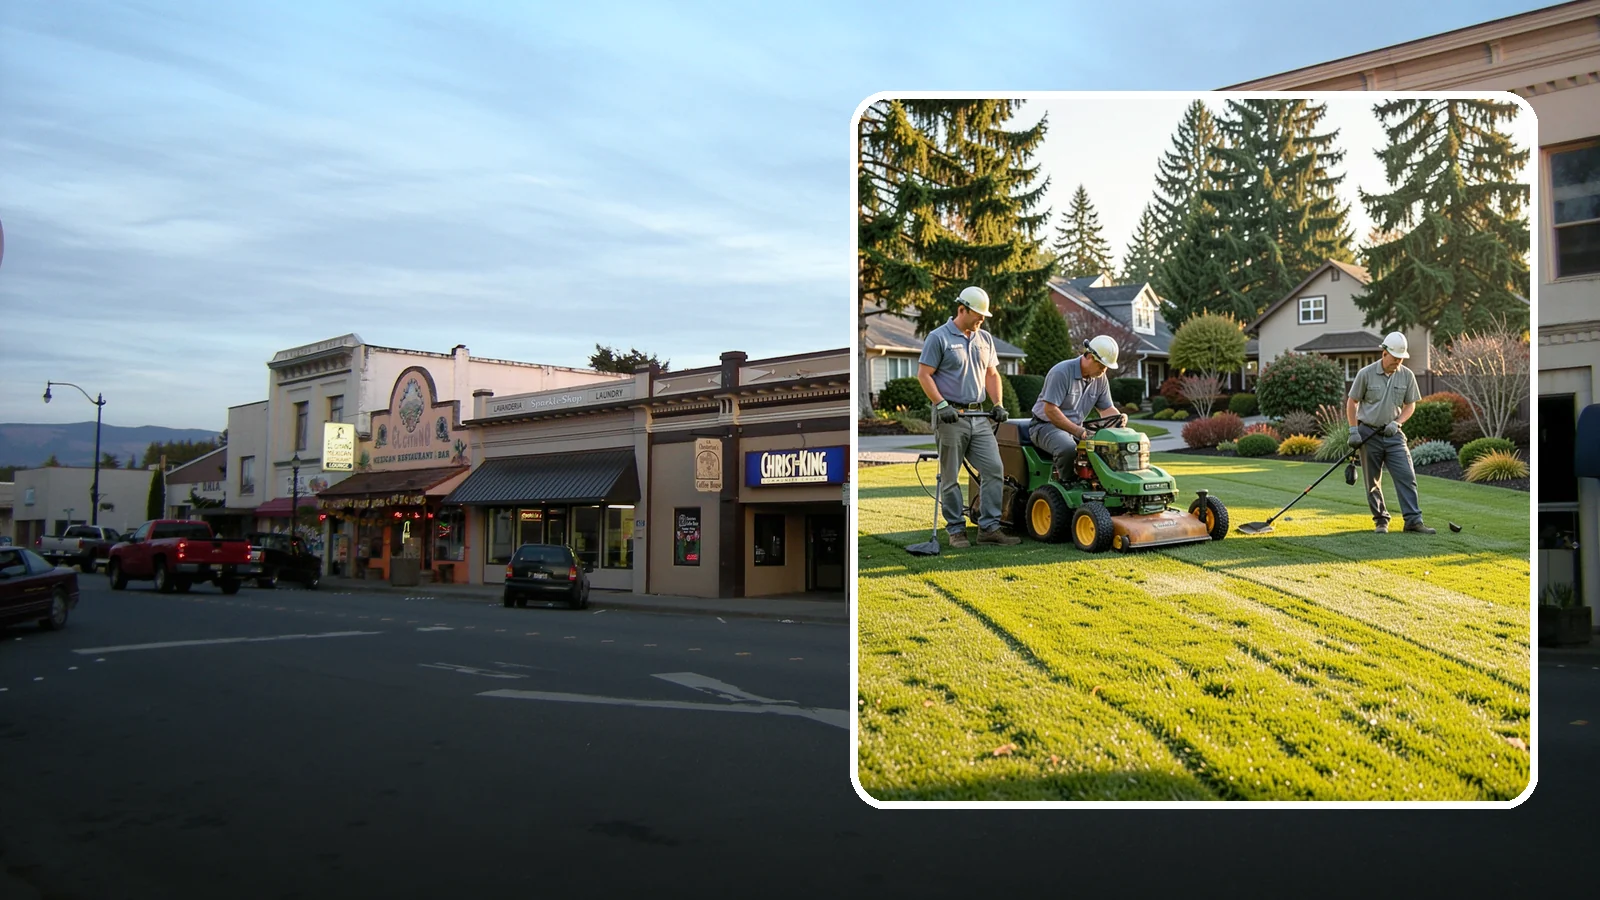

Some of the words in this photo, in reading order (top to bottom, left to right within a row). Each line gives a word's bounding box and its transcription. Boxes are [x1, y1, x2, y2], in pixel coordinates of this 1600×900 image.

[595, 389, 623, 400] LAUNDRY
[493, 402, 522, 413] LAVANDERIA
[373, 454, 396, 464] MEXICAN
[397, 451, 433, 462] RESTAURANT
[437, 450, 450, 458] BAR
[761, 452, 797, 478] CHRIST
[799, 450, 827, 476] KING
